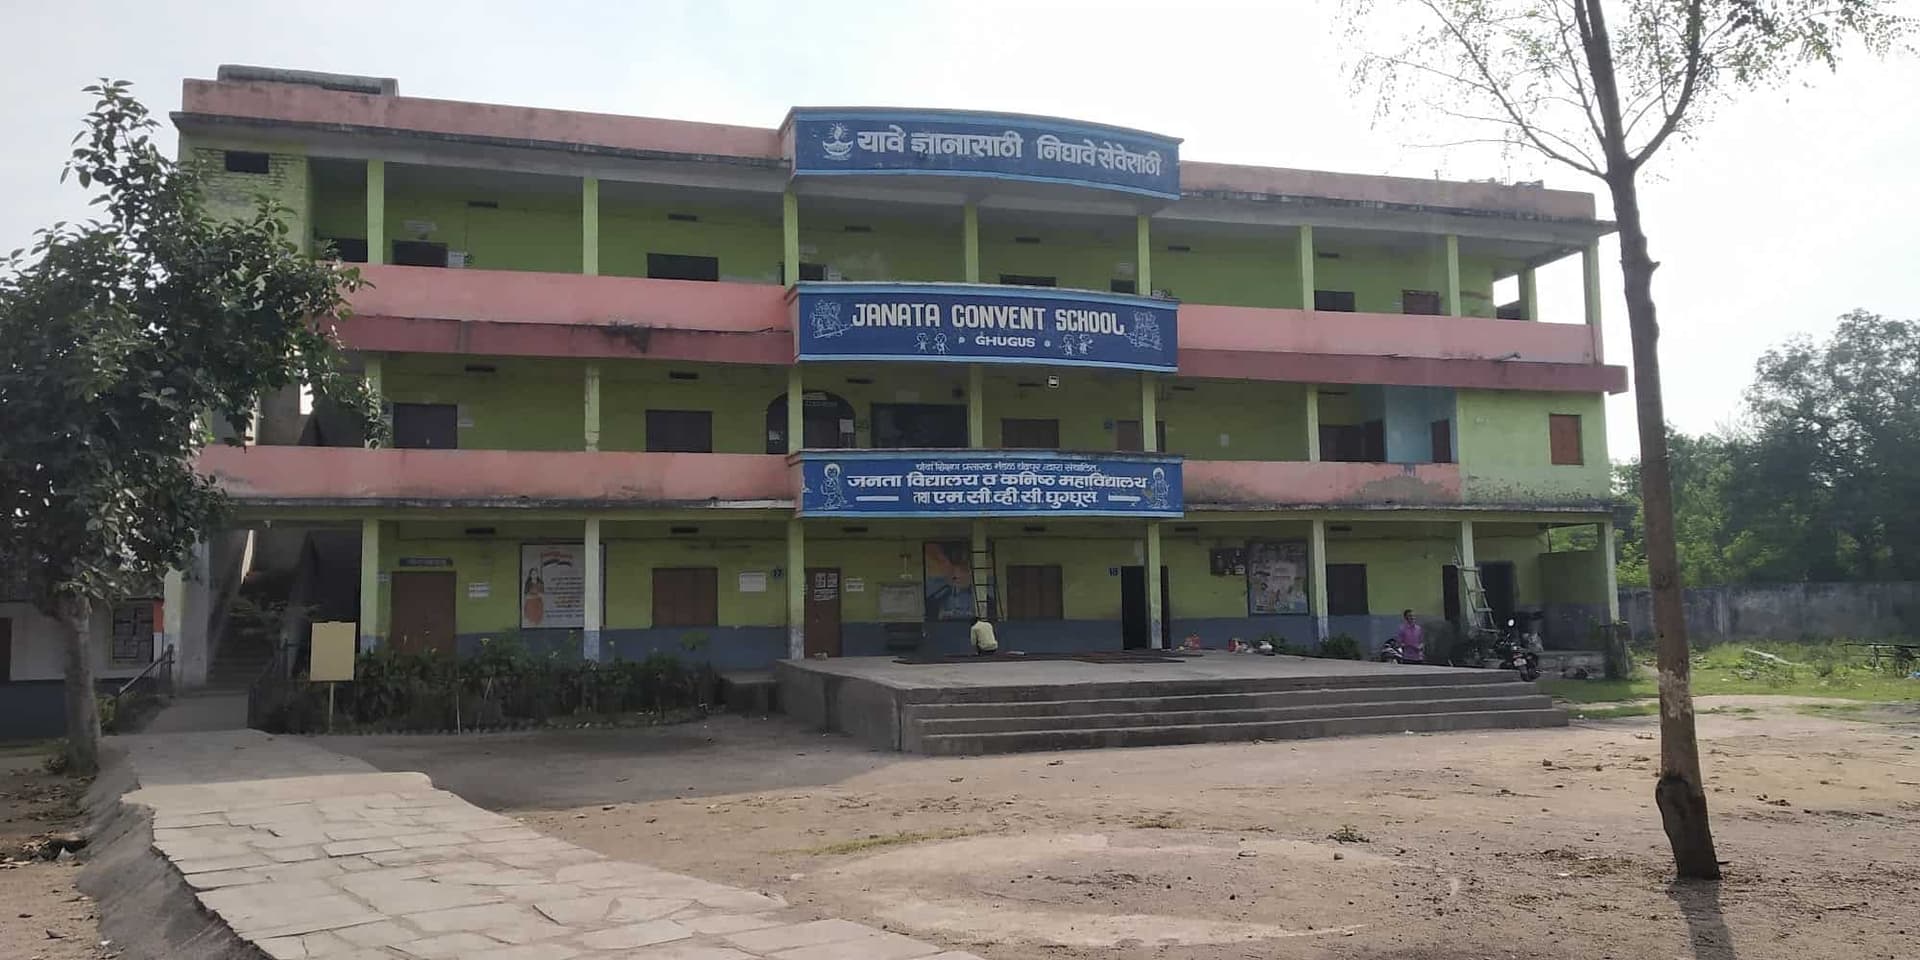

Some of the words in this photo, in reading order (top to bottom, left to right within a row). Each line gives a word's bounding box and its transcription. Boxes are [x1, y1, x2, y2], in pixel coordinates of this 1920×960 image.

[857, 124, 906, 153] यावे
[911, 130, 1024, 158] ज्ञानासाठी
[1097, 141, 1162, 176] सेवेसाठी
[852, 303, 941, 328] JANATA
[951, 304, 1046, 331] CONVENT
[1055, 308, 1125, 335] SCHOOL
[975, 334, 1036, 348] GHUGUS
[847, 474, 903, 488] जनता
[906, 471, 980, 487] विद्यालय
[982, 474, 997, 486] व
[1000, 471, 1057, 486] कनिष्ठ
[1058, 472, 1148, 489] महाविद्यालय
[913, 491, 931, 505] तथा
